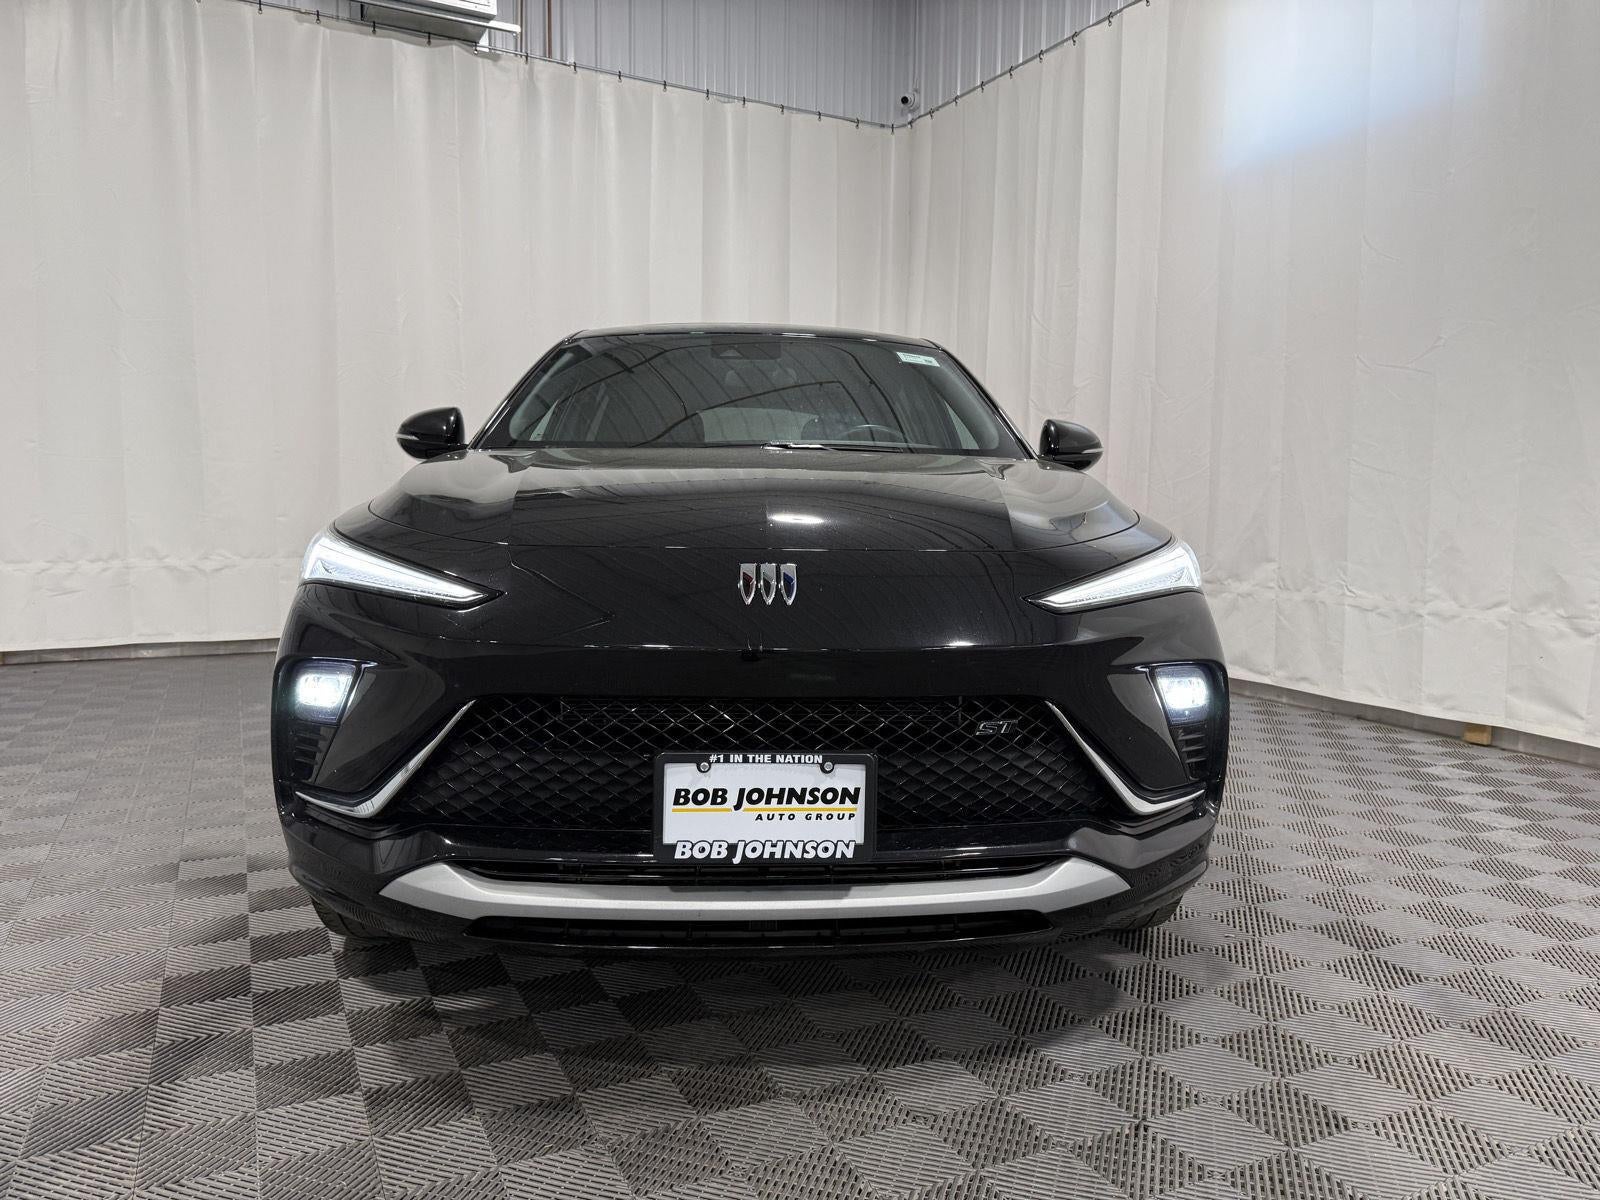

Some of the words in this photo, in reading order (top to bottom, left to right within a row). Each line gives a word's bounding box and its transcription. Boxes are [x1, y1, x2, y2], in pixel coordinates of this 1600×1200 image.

[975, 720, 1018, 735] ST
[709, 754, 724, 763] #1
[729, 754, 743, 763] IN
[747, 754, 772, 763] THE
[775, 755, 823, 764] NATION
[672, 788, 728, 806] BOB
[733, 787, 861, 811] JOHNSON
[755, 813, 796, 821] AUTO
[805, 813, 856, 821] GROUP
[674, 840, 728, 859] BOB
[732, 840, 857, 864] JOHNSON
